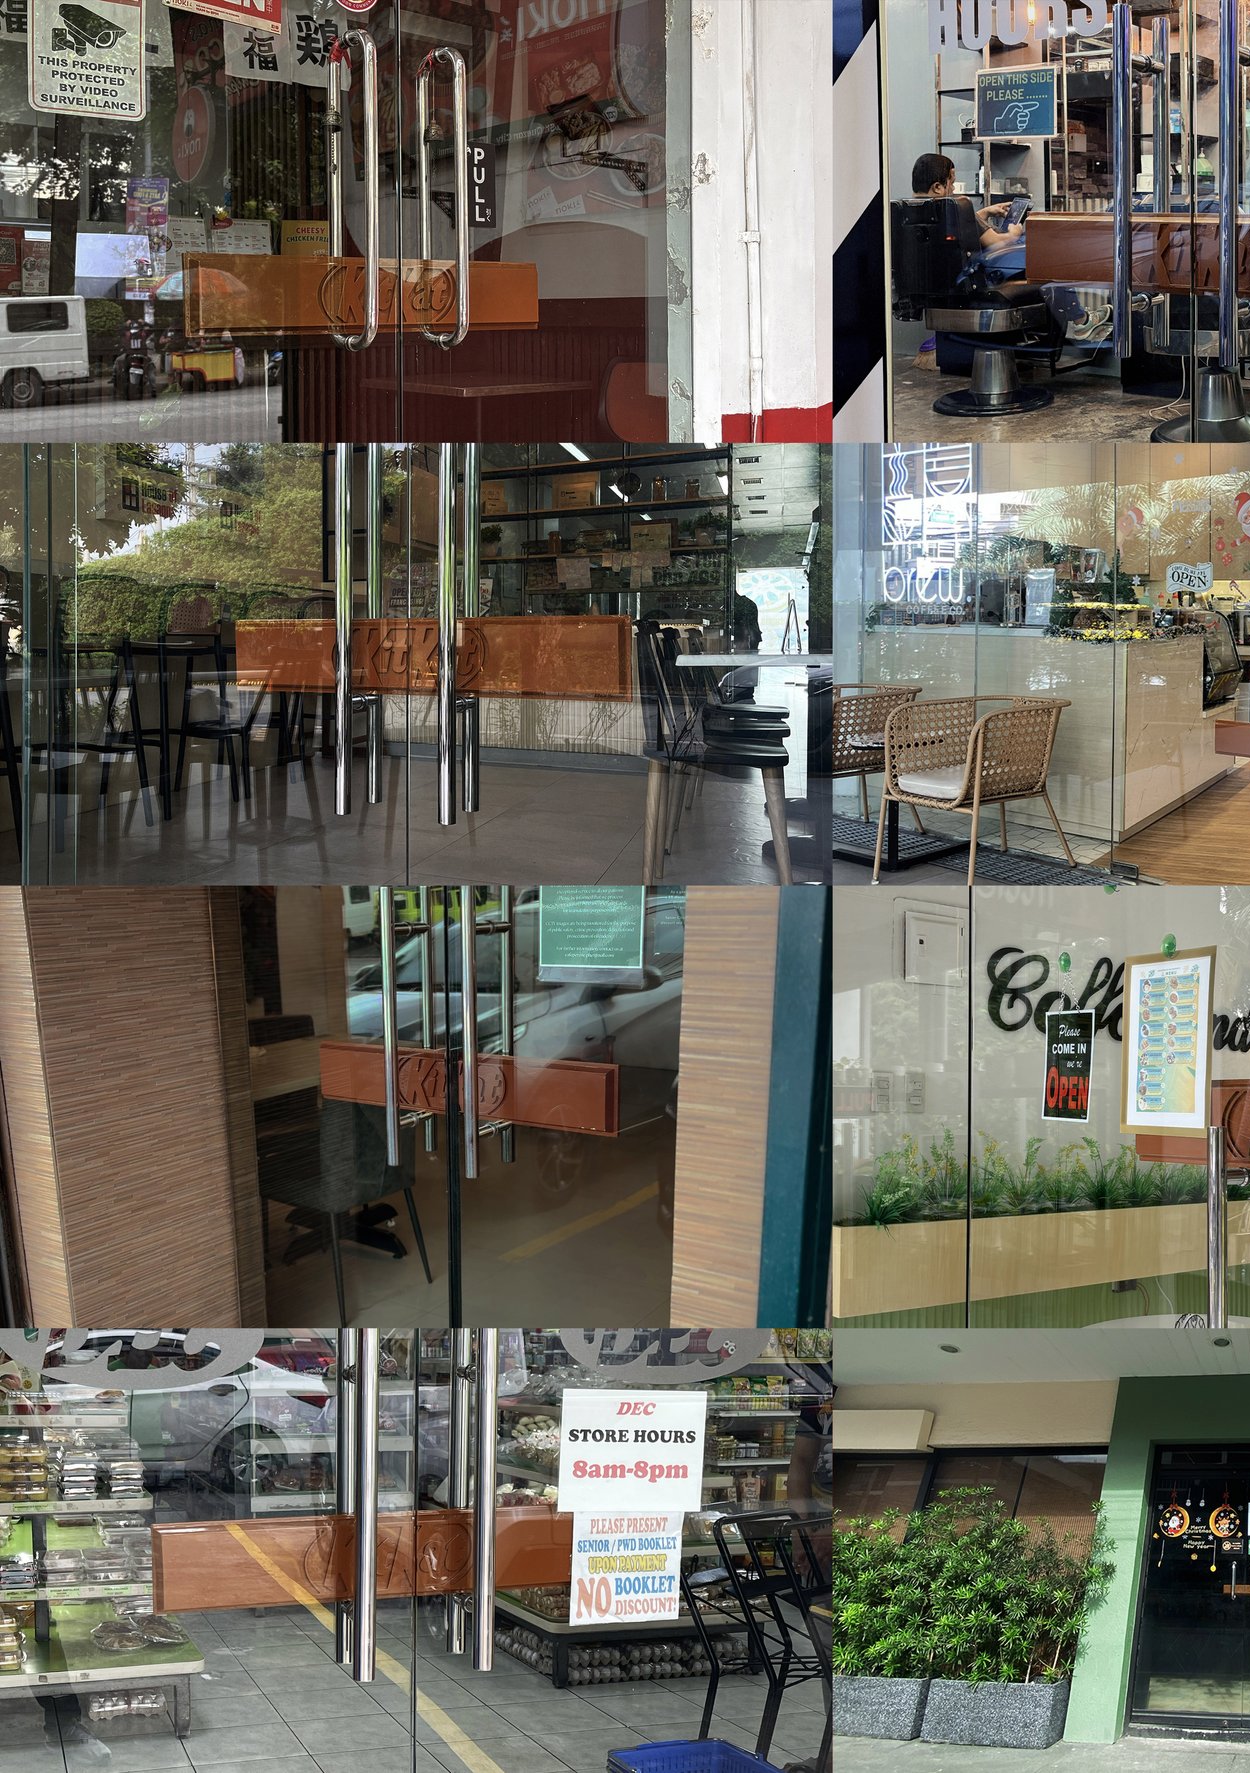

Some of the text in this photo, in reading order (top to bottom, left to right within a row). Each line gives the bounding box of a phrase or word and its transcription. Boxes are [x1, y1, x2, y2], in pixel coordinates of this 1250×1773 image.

[38, 55, 137, 76] THIS PROPERTY
[51, 70, 125, 86] PROTECTED
[979, 71, 1053, 87] OPEN THIS SIDE
[59, 83, 118, 97] BY VIDEO
[986, 88, 1024, 102] PLEASE
[40, 93, 136, 111] SURVEILLANCE
[473, 147, 486, 222] PULL
[286, 235, 314, 243] CHICKEN
[1171, 571, 1207, 588] OPEN
[906, 605, 947, 615] COFFEE
[1058, 1023, 1081, 1038] Please
[1052, 1043, 1087, 1054] COME IN
[1046, 1065, 1088, 1111] OPEN
[617, 1402, 656, 1416] DEC
[569, 1429, 696, 1443] STORE HOURS
[572, 1460, 688, 1482] 8am-8pm
[590, 1517, 668, 1534] PLEASE PRESENT
[577, 1539, 609, 1553] SENIOR
[617, 1538, 636, 1551] PWD
[638, 1537, 677, 1551] BOOKLET
[588, 1554, 667, 1574] UPON PAYMENT
[576, 1576, 675, 1619] NO BOOKLET
[615, 1597, 676, 1616] DISCOUNT!
